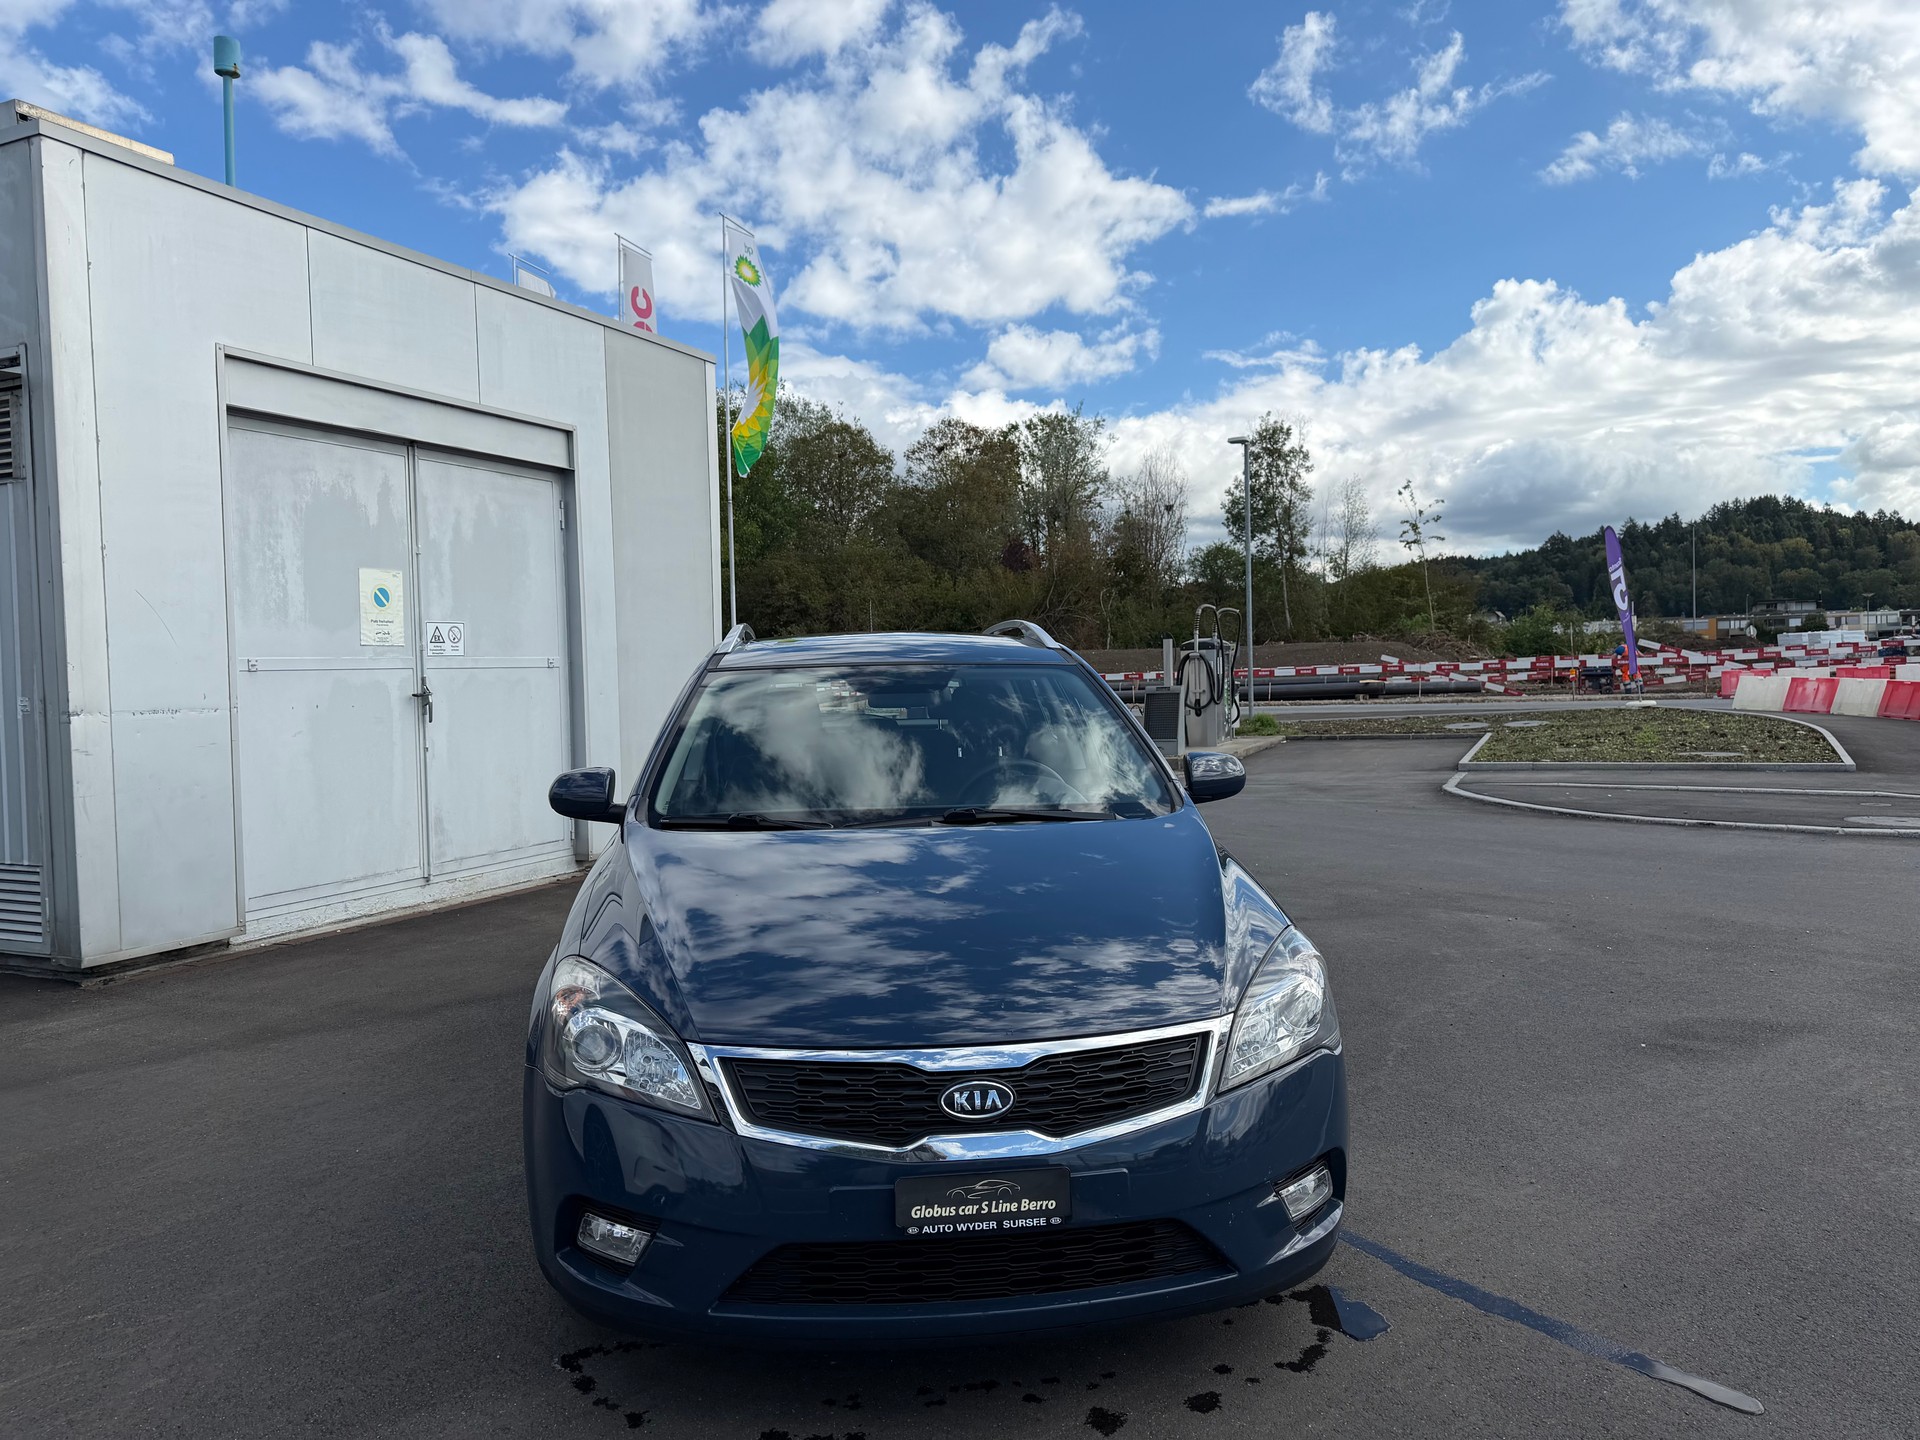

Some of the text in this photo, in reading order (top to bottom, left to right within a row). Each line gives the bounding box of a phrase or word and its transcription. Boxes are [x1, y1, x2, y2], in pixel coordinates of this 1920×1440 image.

[953, 1089, 1003, 1112] KIA
[911, 1199, 1056, 1219] Globus car S Line Berro
[922, 1224, 954, 1234] AUTO
[956, 1221, 997, 1232] WYDER
[1003, 1217, 1047, 1228] SURSEE
